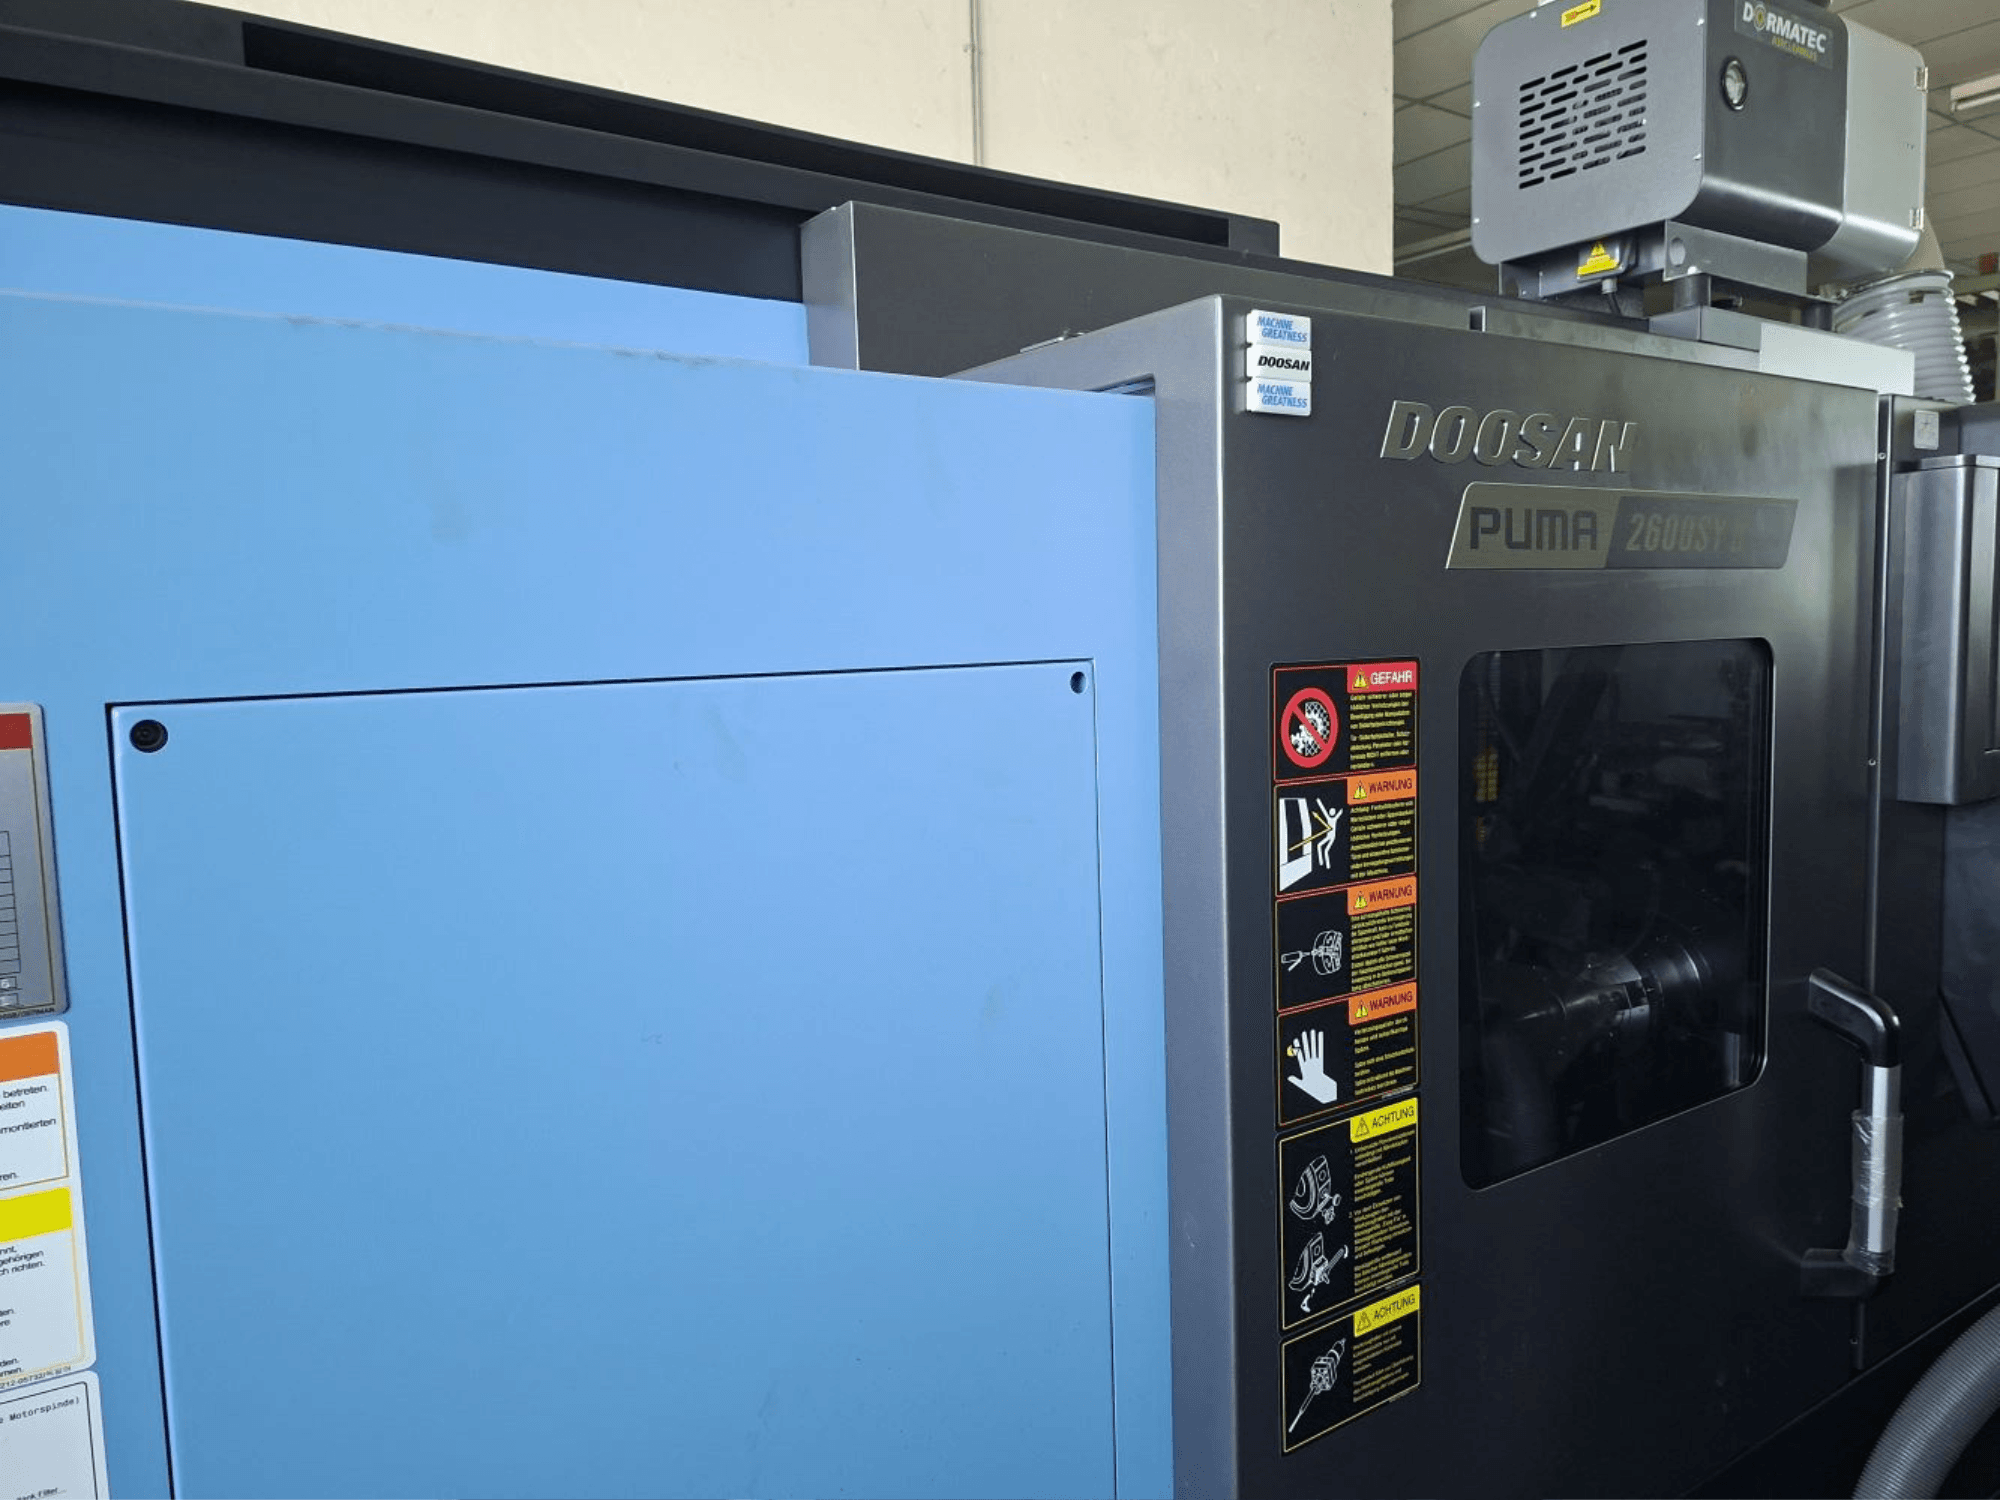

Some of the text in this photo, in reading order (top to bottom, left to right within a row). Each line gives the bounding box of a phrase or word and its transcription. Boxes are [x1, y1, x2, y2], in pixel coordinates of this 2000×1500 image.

[1742, 1, 1827, 54] DORMATEC
[1257, 316, 1294, 331] MACHINE
[1262, 327, 1308, 343] GREATNESS
[1257, 355, 1311, 371] DOOSAN
[1257, 383, 1294, 396] MACHINE
[1262, 395, 1308, 409] GREATNESS
[1380, 400, 1638, 473] DOOSAN
[1470, 507, 1597, 552] PUMA
[1370, 670, 1413, 685] GEFAHR
[1368, 778, 1413, 794] WARNUNG
[1368, 885, 1413, 902] WARNUNG
[1369, 991, 1413, 1011] WARNUNG
[1371, 1105, 1414, 1129] ACHTUNG
[1373, 1293, 1416, 1319] ACHTUNG
